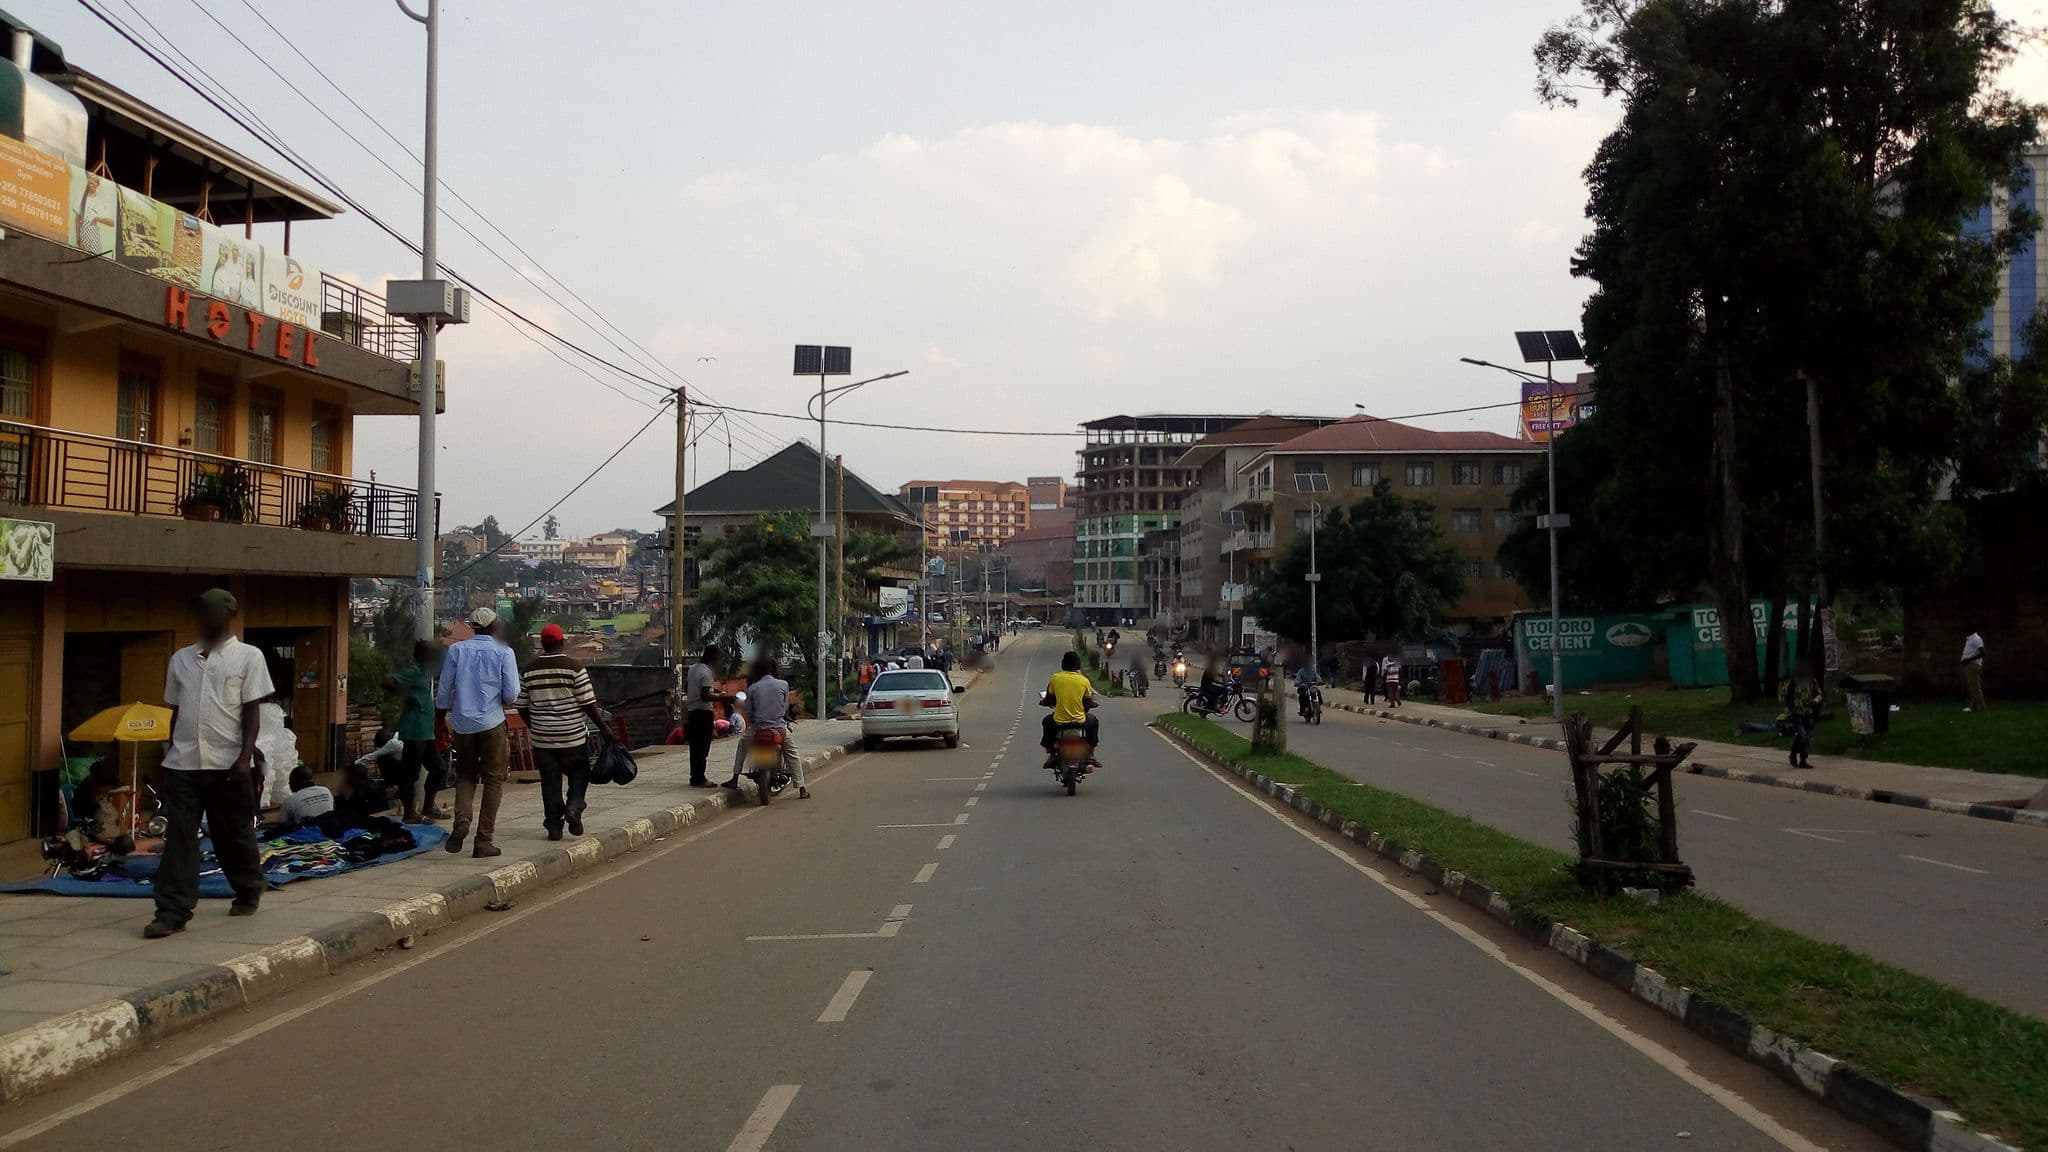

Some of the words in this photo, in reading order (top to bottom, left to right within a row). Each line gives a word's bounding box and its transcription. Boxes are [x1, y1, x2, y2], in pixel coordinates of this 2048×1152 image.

[269, 283, 318, 317] DISCOUNT
[279, 306, 308, 327] HOTEL
[165, 286, 320, 368] HOTEL
